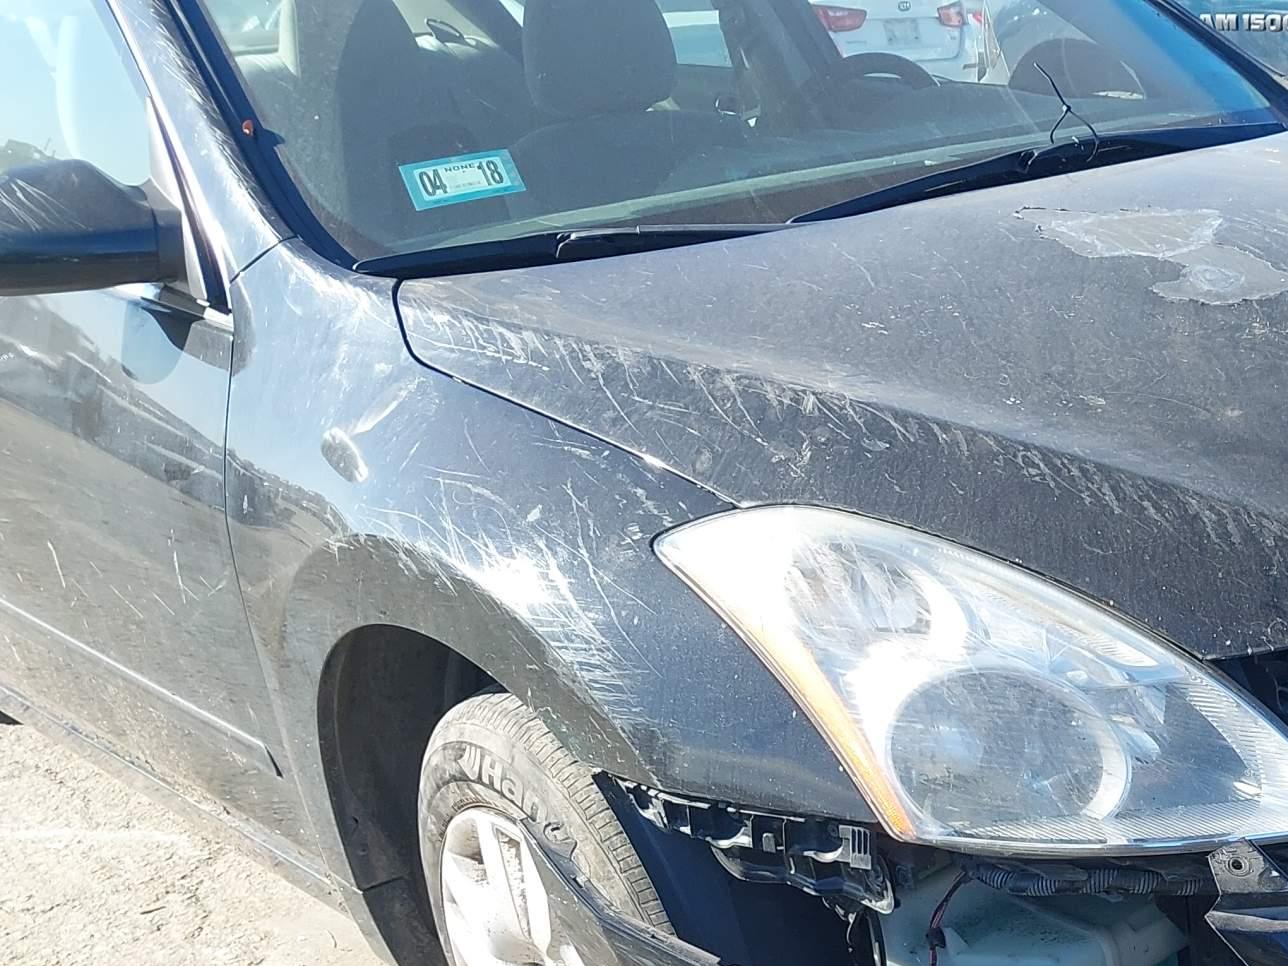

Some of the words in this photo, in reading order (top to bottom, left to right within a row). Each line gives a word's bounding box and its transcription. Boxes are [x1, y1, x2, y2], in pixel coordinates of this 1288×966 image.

[1200, 13, 1238, 32] AM
[419, 168, 448, 197] 04
[477, 159, 504, 186] 18
